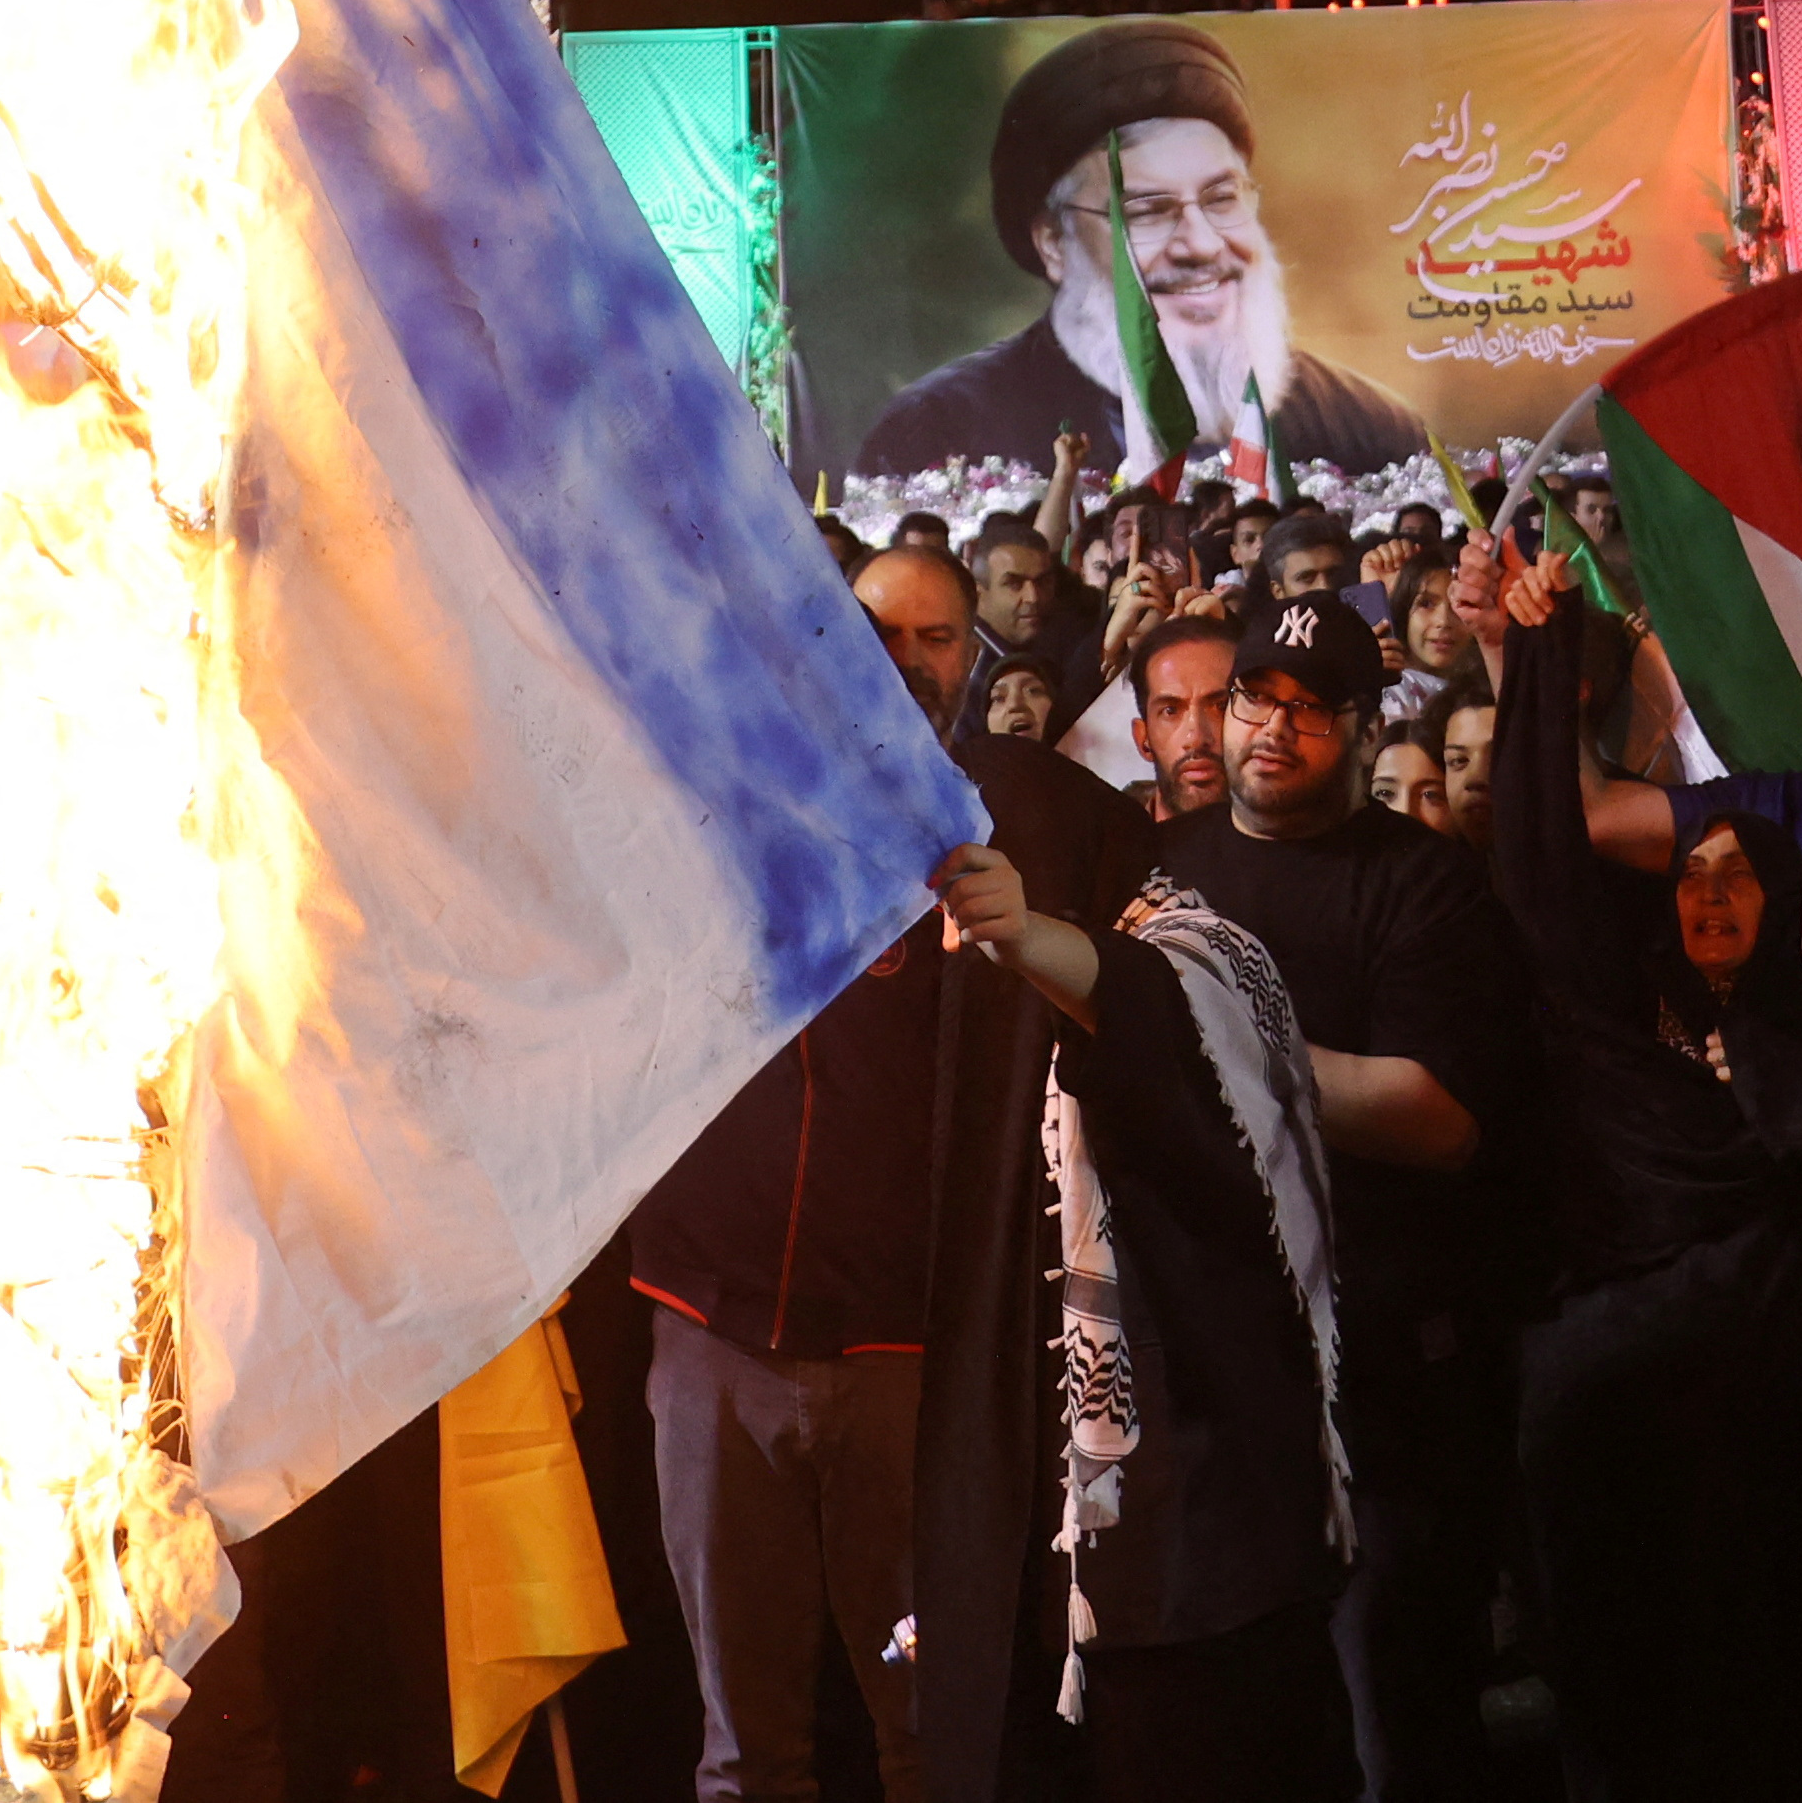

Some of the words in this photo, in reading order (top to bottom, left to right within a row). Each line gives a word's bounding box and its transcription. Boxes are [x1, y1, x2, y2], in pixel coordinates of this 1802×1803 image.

[1404, 220, 1632, 284] شهید
[1407, 281, 1547, 328] مقاومت
[1556, 288, 1633, 321] سید
[1274, 604, 1319, 649] NY
